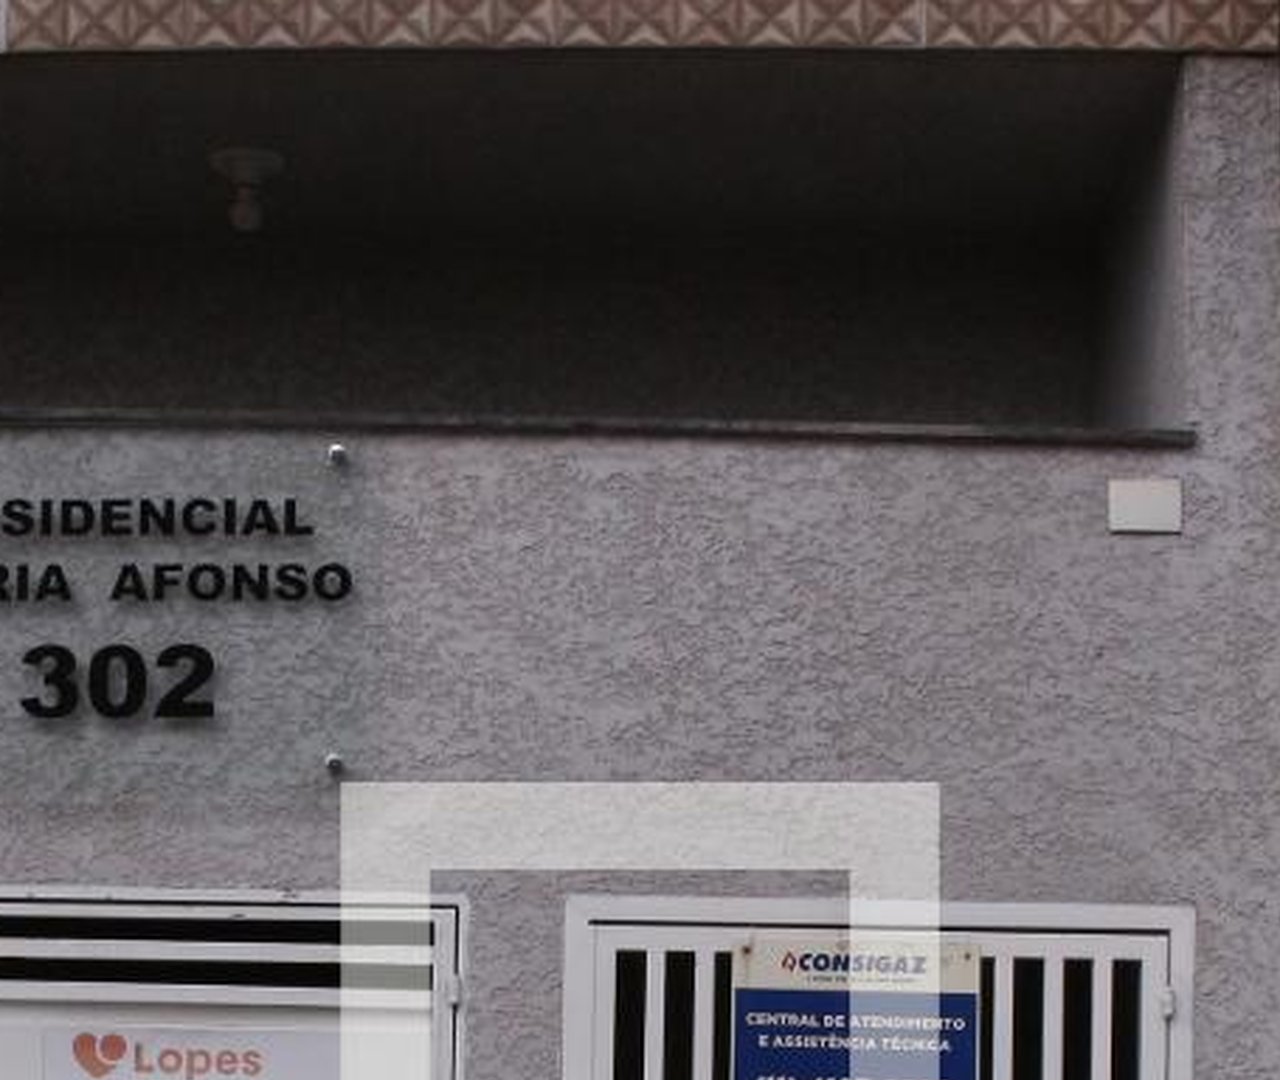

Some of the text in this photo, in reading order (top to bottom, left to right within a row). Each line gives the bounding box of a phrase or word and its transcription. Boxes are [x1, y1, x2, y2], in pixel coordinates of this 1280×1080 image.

[111, 564, 353, 602] AFONSO
[20, 644, 215, 719] 302
[800, 953, 927, 975] CONSIGAZ
[745, 1012, 966, 1031] CENTRAL DE ATENDIMENTO
[758, 1032, 952, 1052] E ASSISTÊNCIA TÉCNICA
[134, 1042, 262, 1080] Lopes
